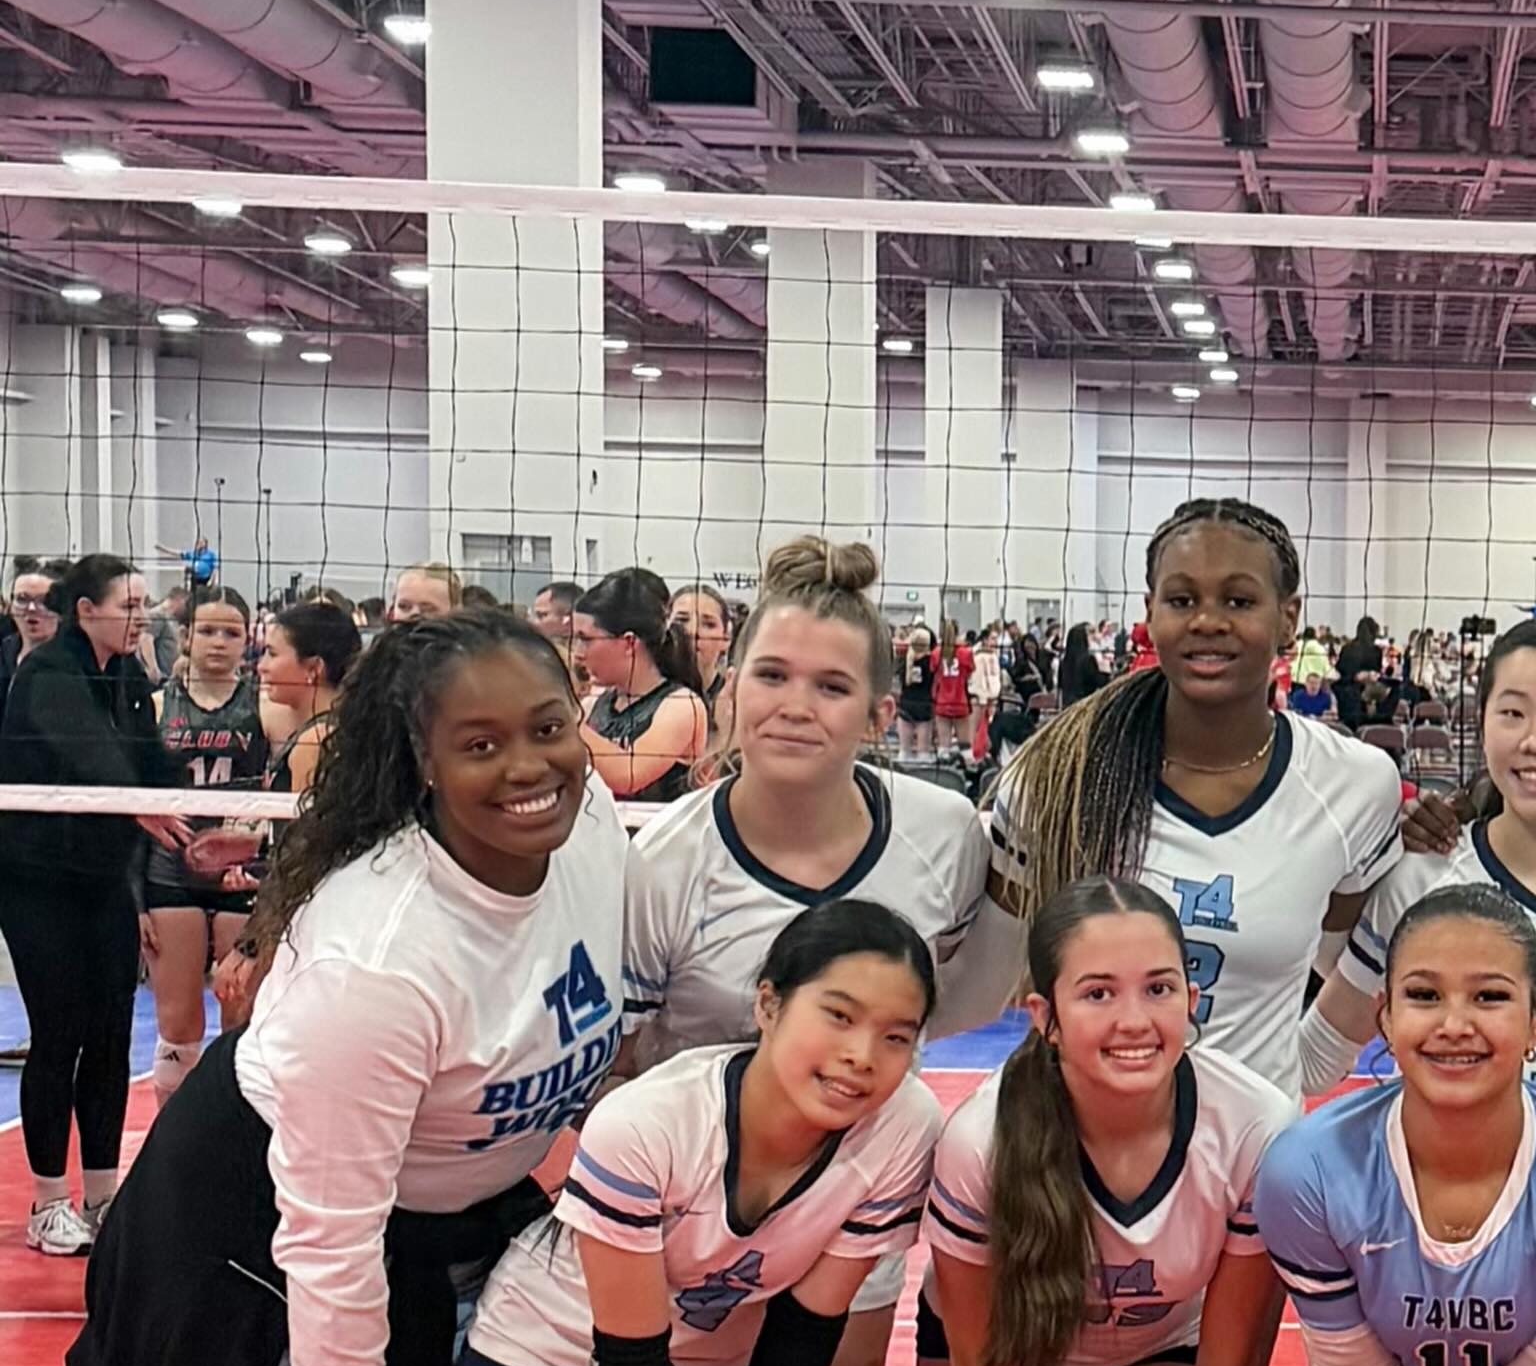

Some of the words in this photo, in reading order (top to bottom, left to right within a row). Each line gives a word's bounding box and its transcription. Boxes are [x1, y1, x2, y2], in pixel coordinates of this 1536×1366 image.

[186, 755, 233, 786] 14
[1173, 874, 1235, 926] T4
[542, 939, 613, 1049] T4
[1402, 1293, 1516, 1333] T4VBC
